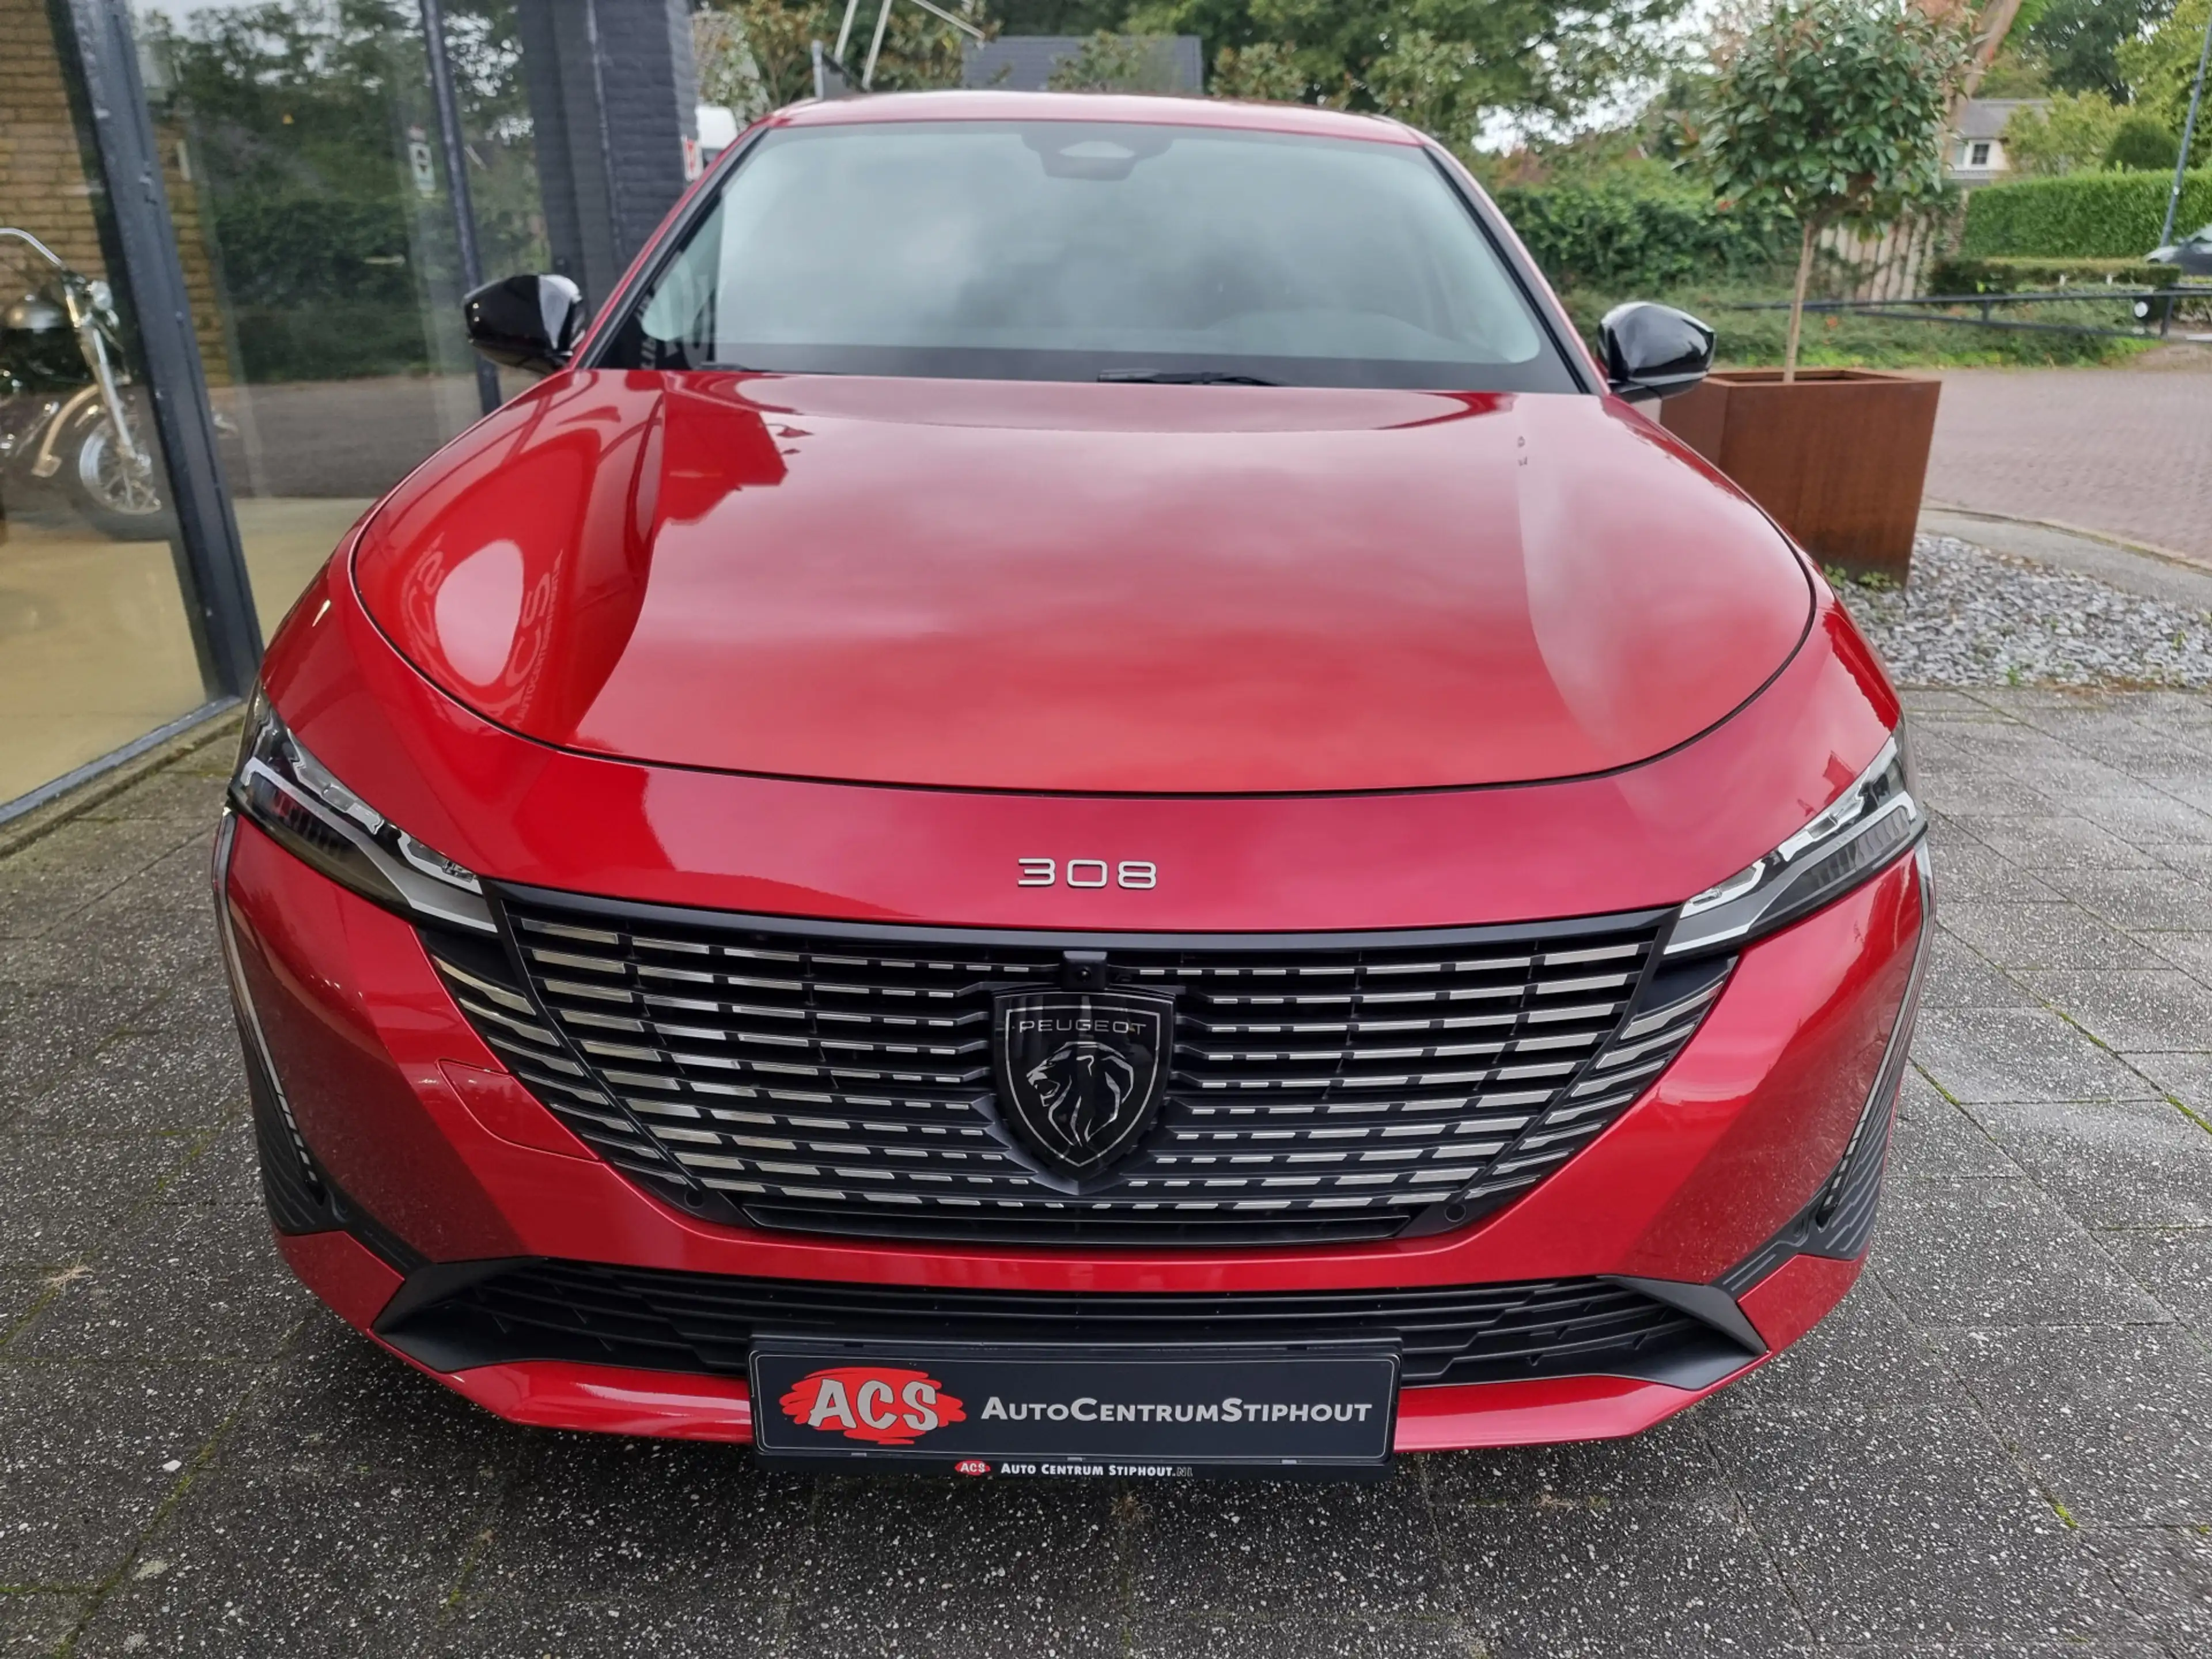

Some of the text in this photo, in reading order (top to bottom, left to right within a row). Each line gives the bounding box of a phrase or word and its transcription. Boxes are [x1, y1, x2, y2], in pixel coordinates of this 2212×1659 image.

[1018, 858, 1157, 889] 308
[1018, 1018, 1147, 1035] PEUGEOT
[808, 1378, 940, 1432] ACS
[960, 1461, 986, 1473] ACS
[1001, 1463, 1037, 1475] AUTO
[1041, 1464, 1104, 1476] CENTRUM
